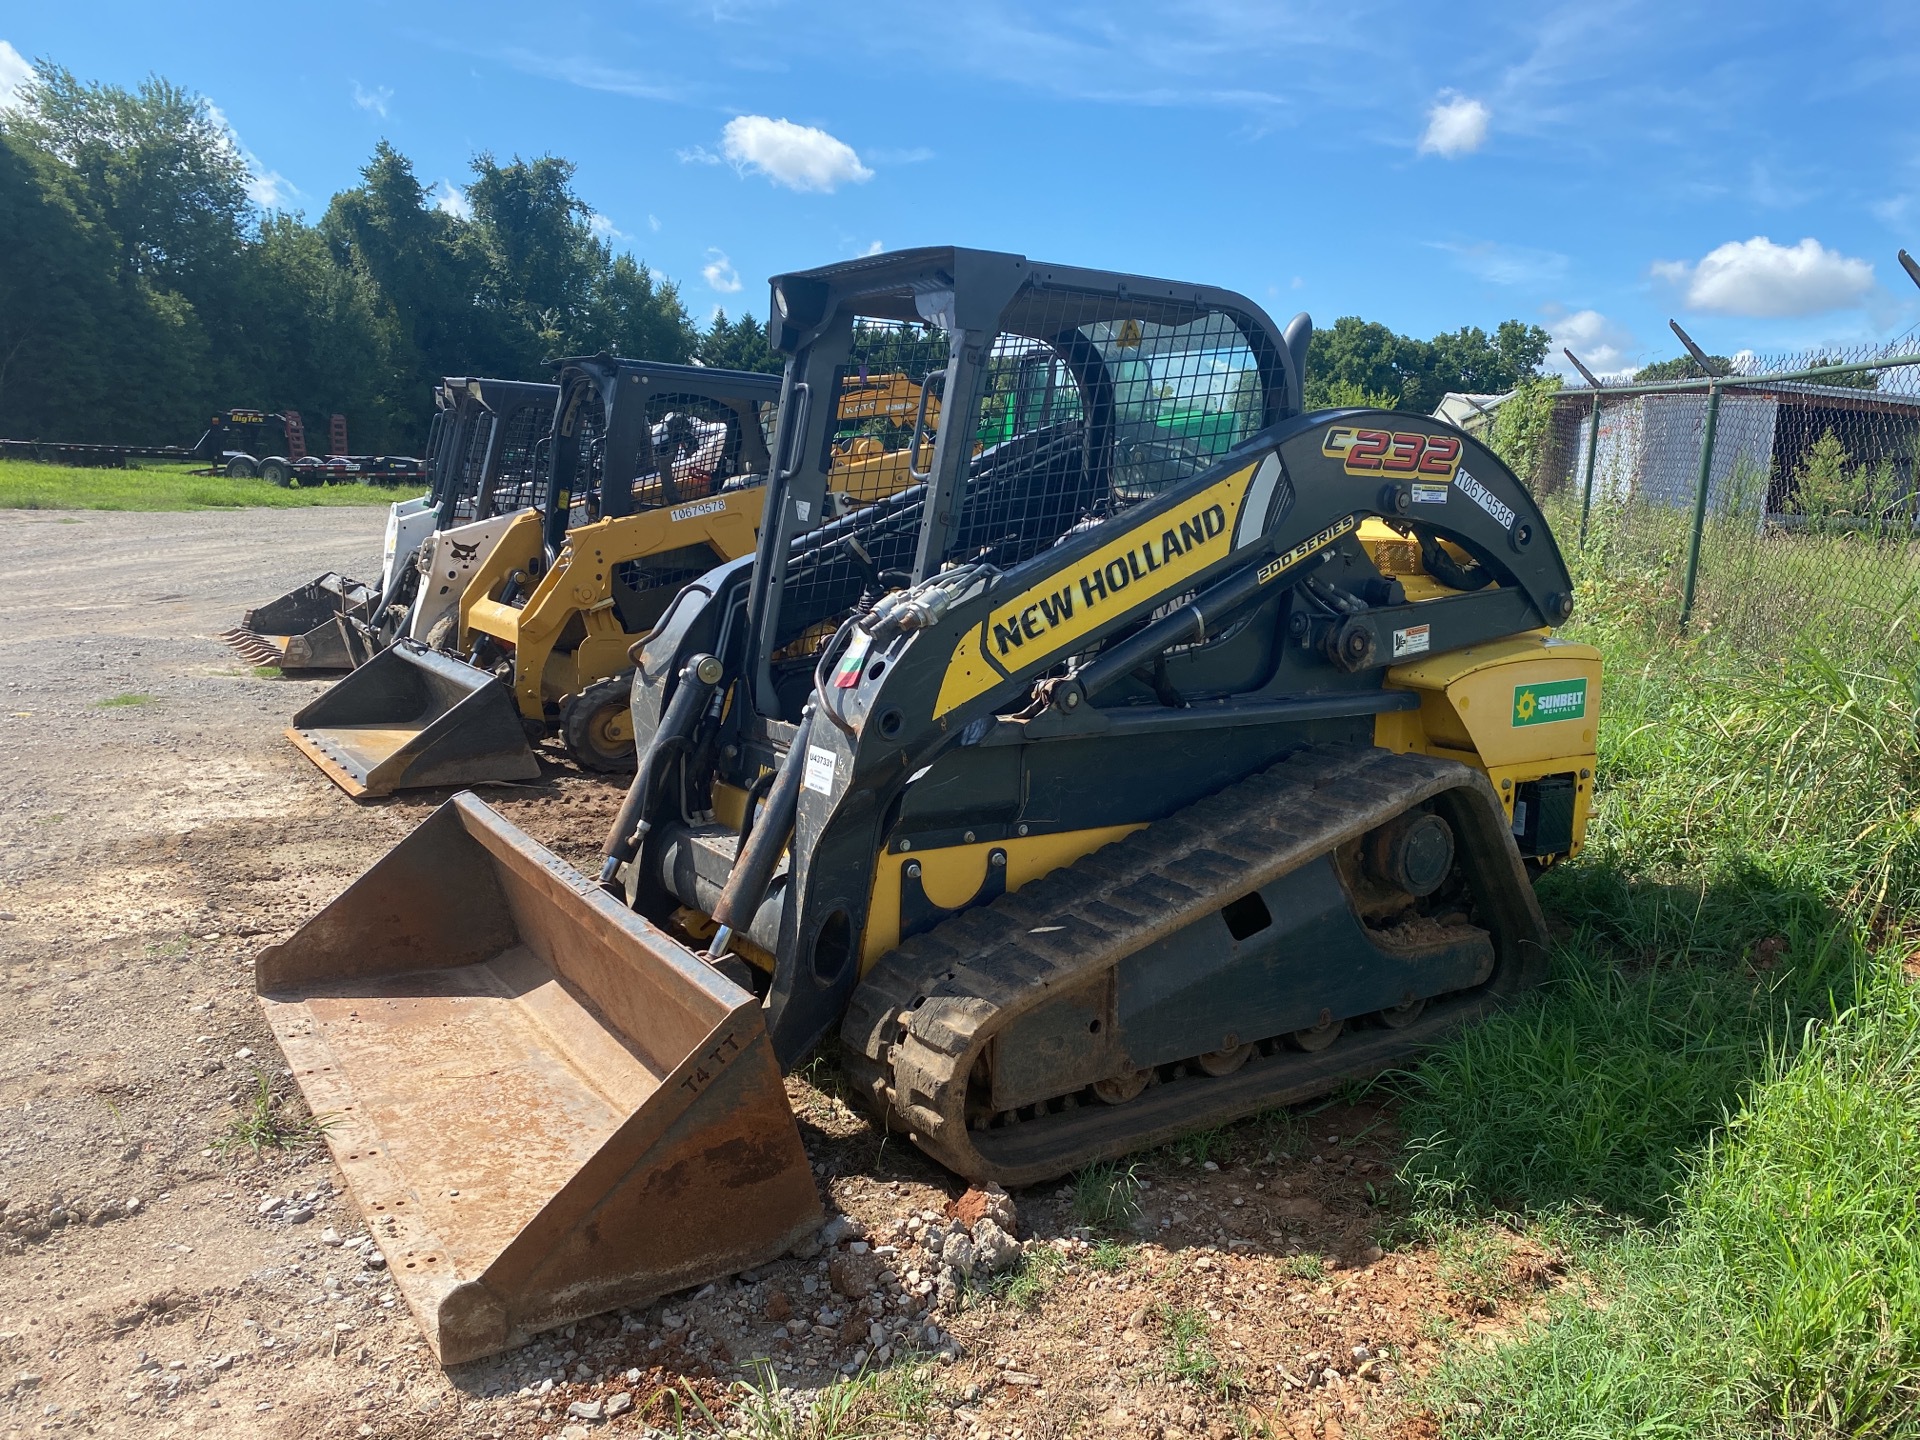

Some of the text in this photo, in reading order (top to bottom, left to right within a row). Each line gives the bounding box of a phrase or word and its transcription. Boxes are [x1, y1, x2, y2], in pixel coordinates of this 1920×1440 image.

[231, 414, 264, 424] BigTex
[1323, 428, 1462, 477] C232
[671, 501, 725, 520] 10679578
[1457, 470, 1514, 530] 10679586
[1258, 516, 1353, 581] 200 SERIES
[993, 503, 1227, 656] NEW HOLLAND
[1537, 690, 1584, 710] SUNBELT
[1543, 705, 1576, 715] RENTALS
